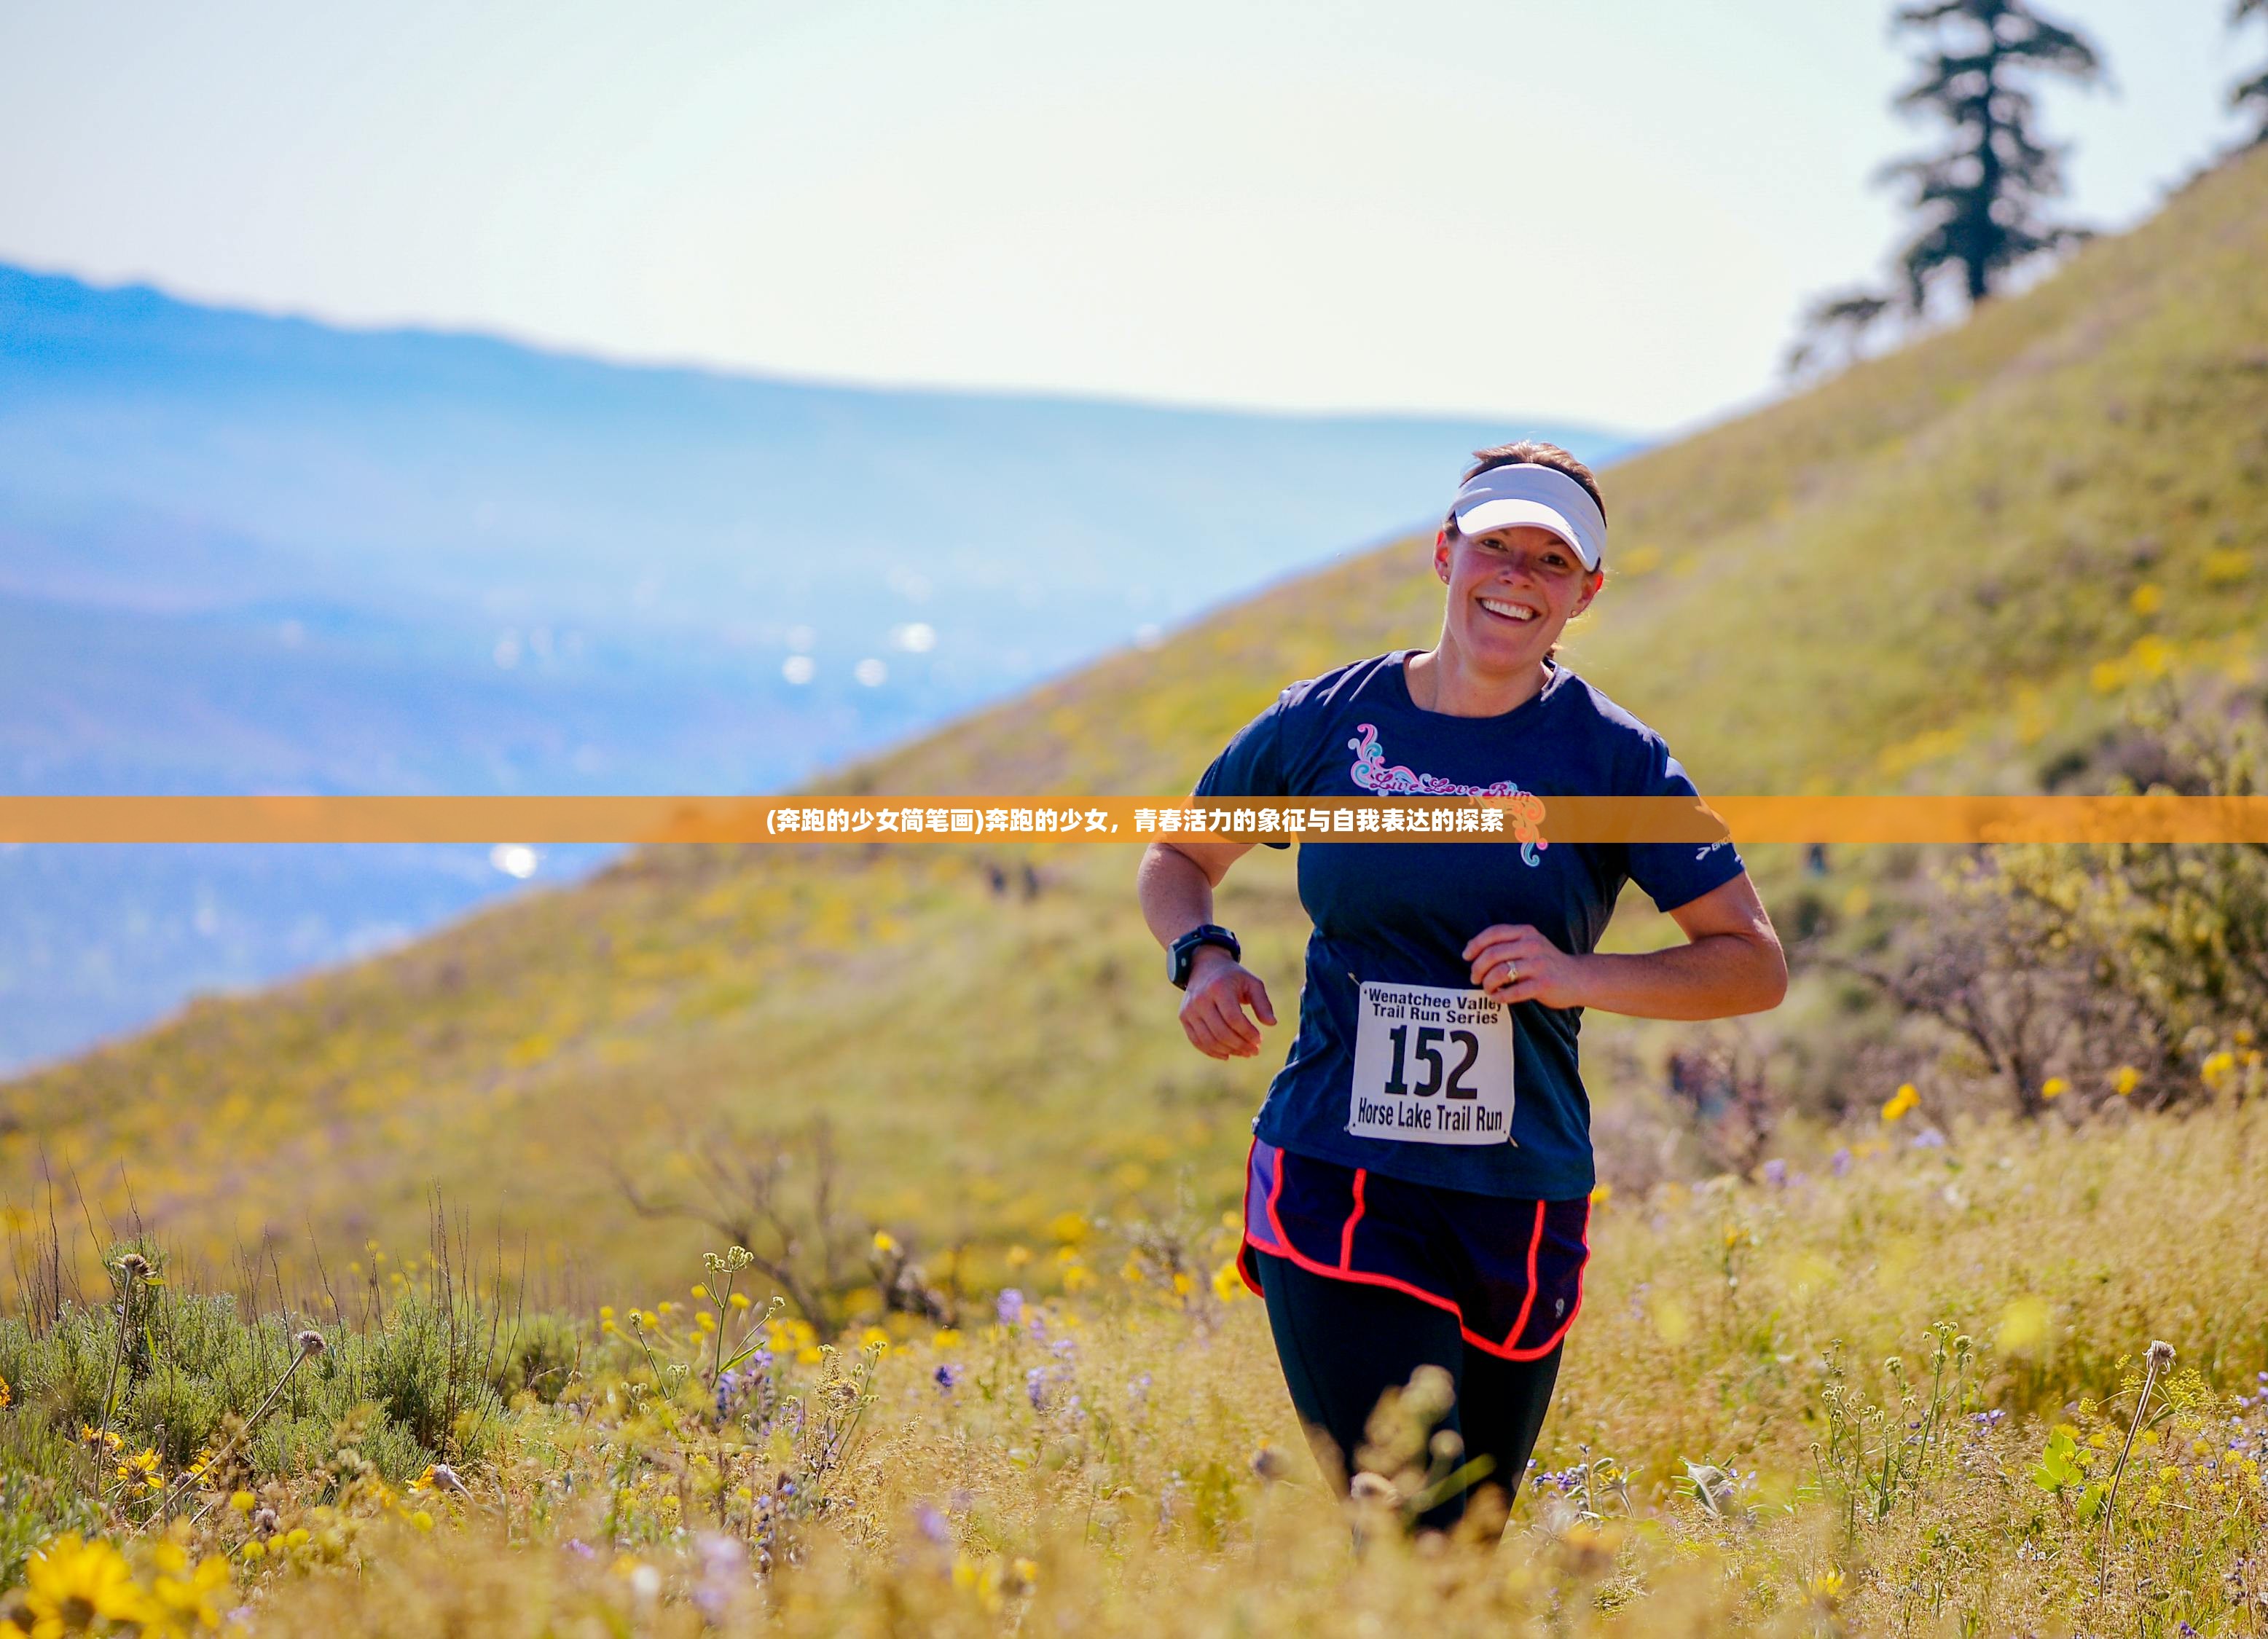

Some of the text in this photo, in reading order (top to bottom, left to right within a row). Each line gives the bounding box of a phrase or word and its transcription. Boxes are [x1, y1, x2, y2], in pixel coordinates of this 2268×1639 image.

[1370, 772, 1419, 793] Live
[1424, 777, 1480, 795] Love
[1369, 988, 1451, 1008] Wenatchee
[1373, 1004, 1499, 1024] Trail Run Series
[1384, 1024, 1479, 1099] 152
[1358, 1097, 1502, 1131] Horse Lake Trail Run
